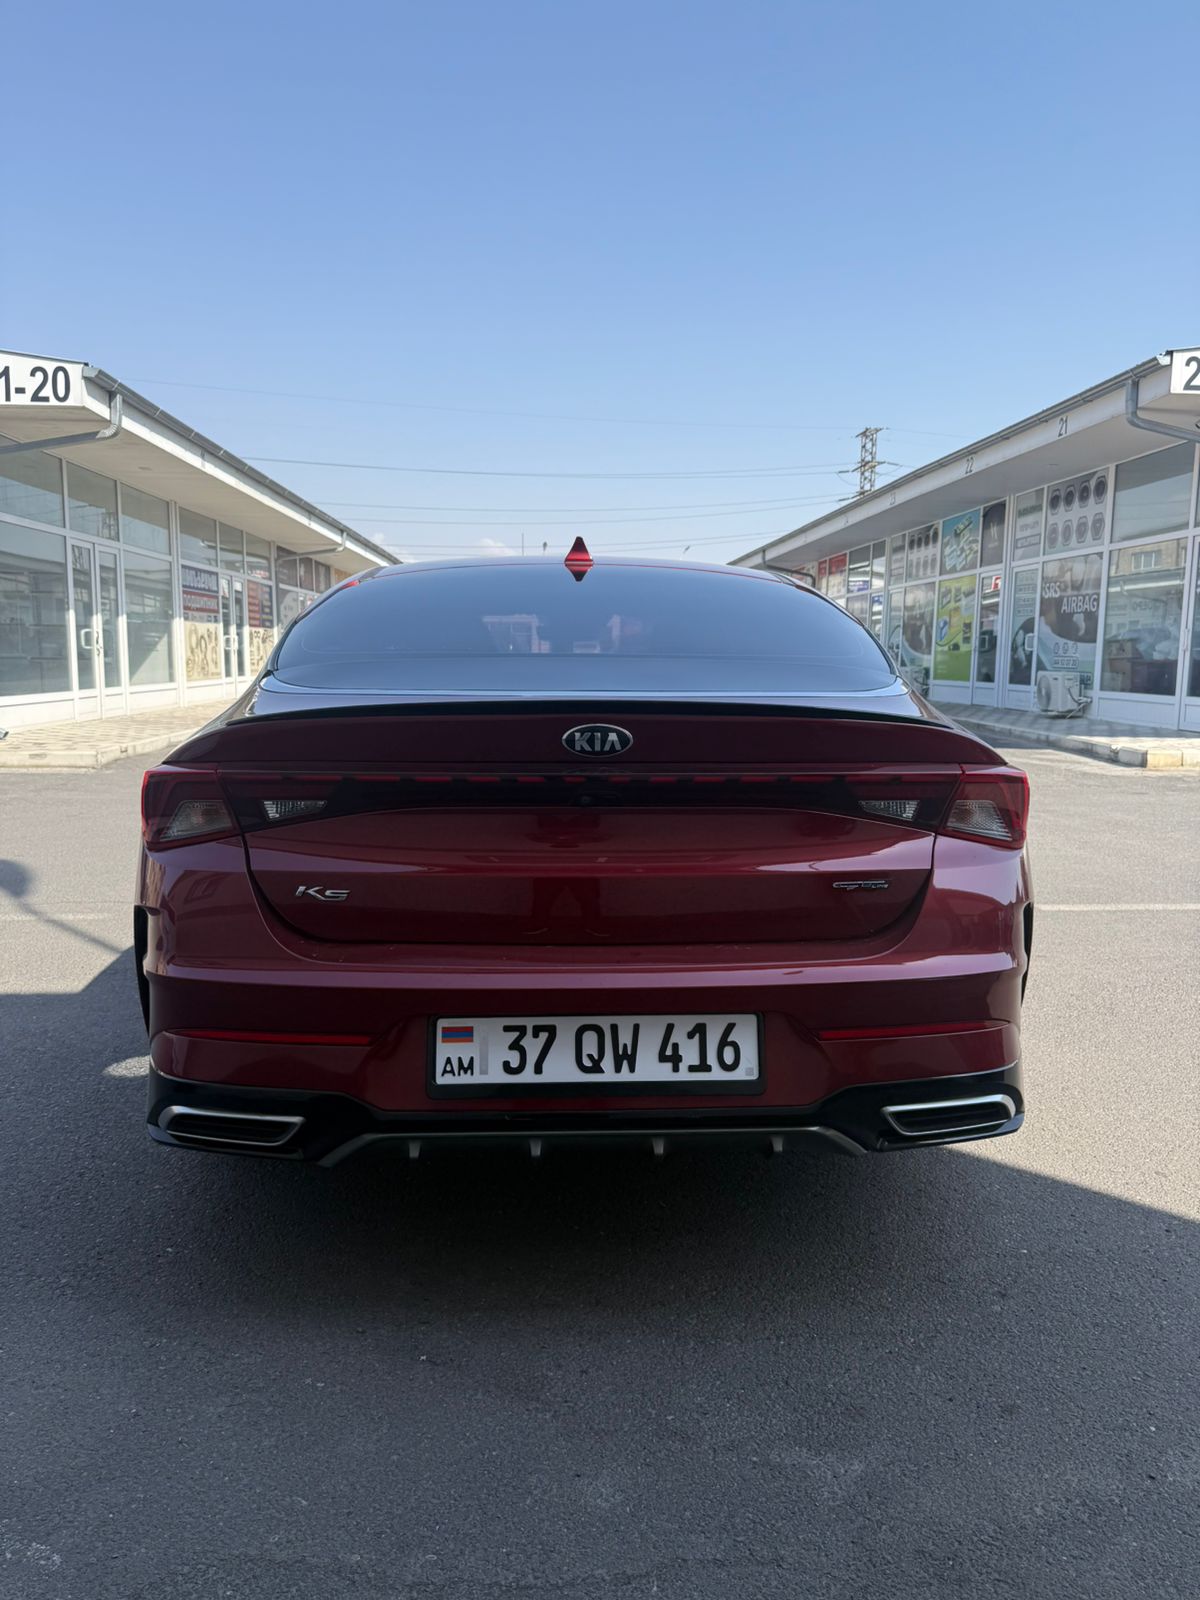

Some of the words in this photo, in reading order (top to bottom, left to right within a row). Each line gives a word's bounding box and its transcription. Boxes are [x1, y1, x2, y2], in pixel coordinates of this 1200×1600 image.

[0, 366, 70, 402] 1-20
[1058, 415, 1068, 437] 21
[964, 457, 974, 474] 22
[1061, 594, 1098, 614] AIRBAG
[574, 732, 621, 752] KIA
[502, 1024, 557, 1075] 37
[574, 1023, 640, 1074] QW
[658, 1022, 741, 1072] 416
[441, 1056, 474, 1077] AM
